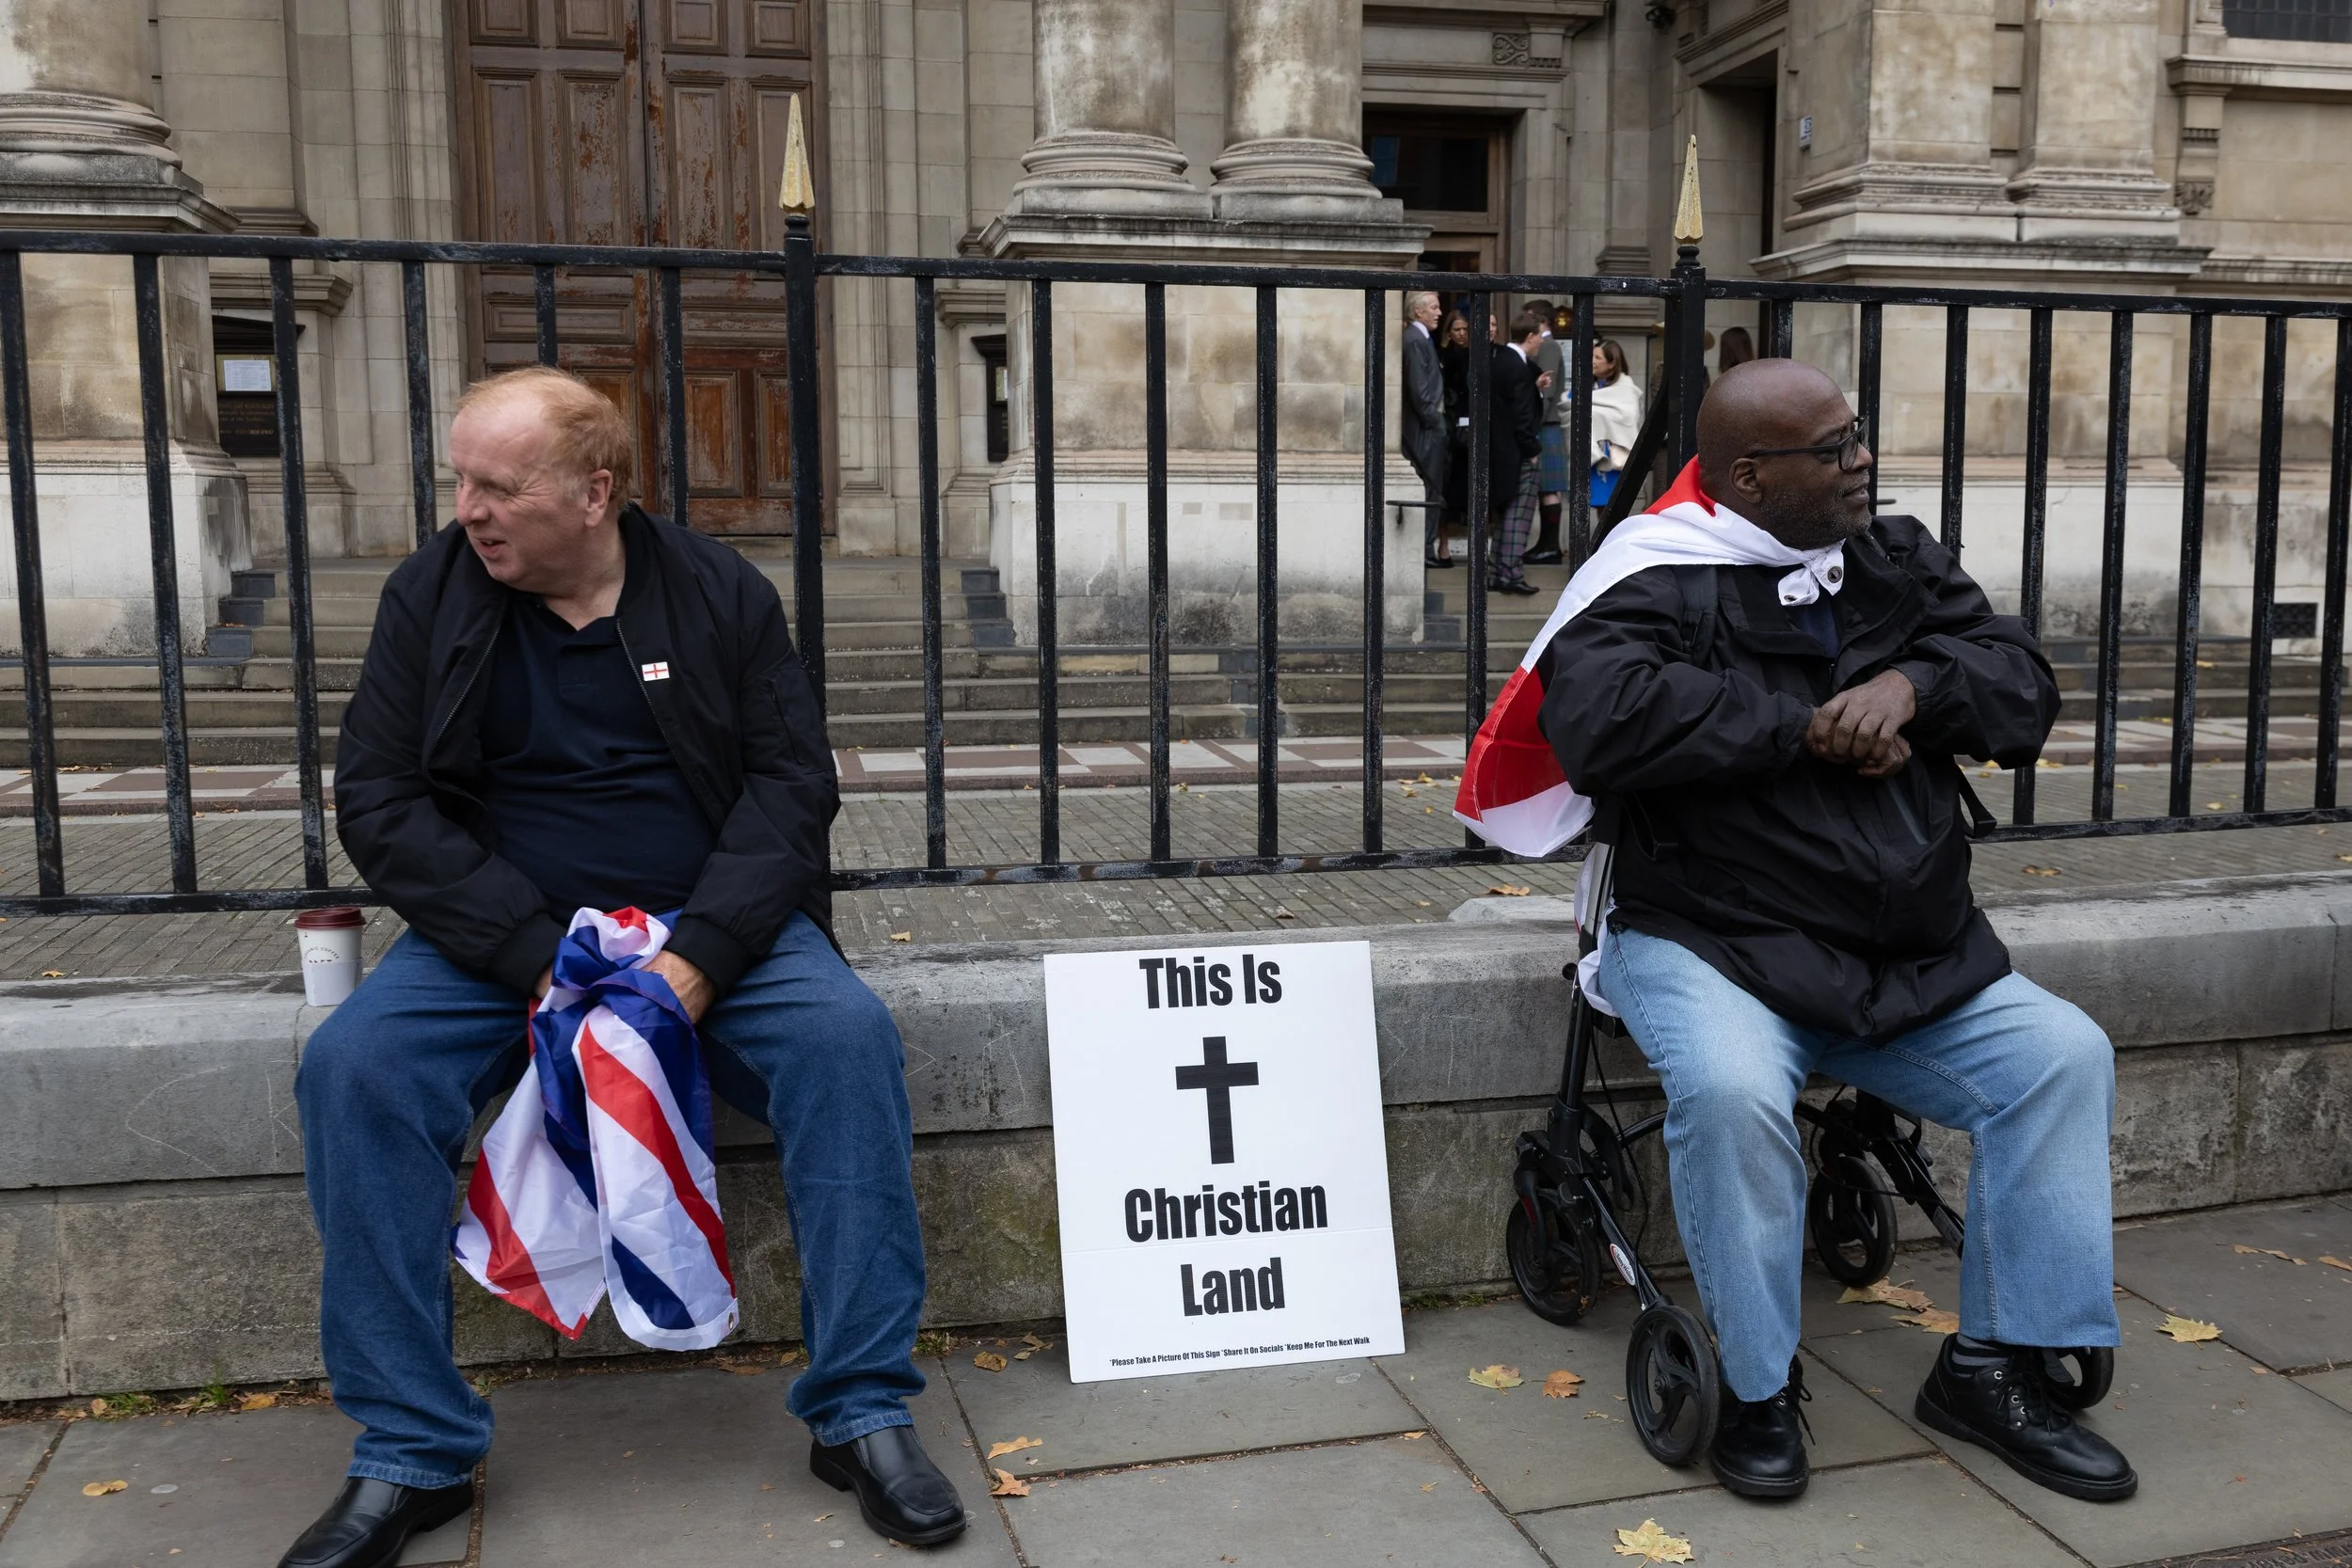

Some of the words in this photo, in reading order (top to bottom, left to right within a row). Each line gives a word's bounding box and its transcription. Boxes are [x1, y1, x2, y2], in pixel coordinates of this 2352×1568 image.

[1139, 955, 1232, 1008] This
[1242, 954, 1282, 1005] Is
[1124, 1180, 1328, 1243] Christian
[1180, 1257, 1286, 1317] Land
[1136, 1355, 1151, 1365] Take
[1152, 1354, 1157, 1363] A
[1158, 1354, 1182, 1363] Picture
[1183, 1352, 1190, 1360] Of
[1191, 1351, 1205, 1360] This
[1205, 1350, 1220, 1359] Sign
[1244, 1347, 1249, 1355] It
[1249, 1346, 1259, 1354] On
[1260, 1344, 1284, 1354] Socials
[1304, 1341, 1314, 1350] Me
[1315, 1340, 1325, 1349] For
[1326, 1338, 1338, 1348] The
[1339, 1338, 1353, 1347] Next
[1354, 1336, 1371, 1345] Walk
